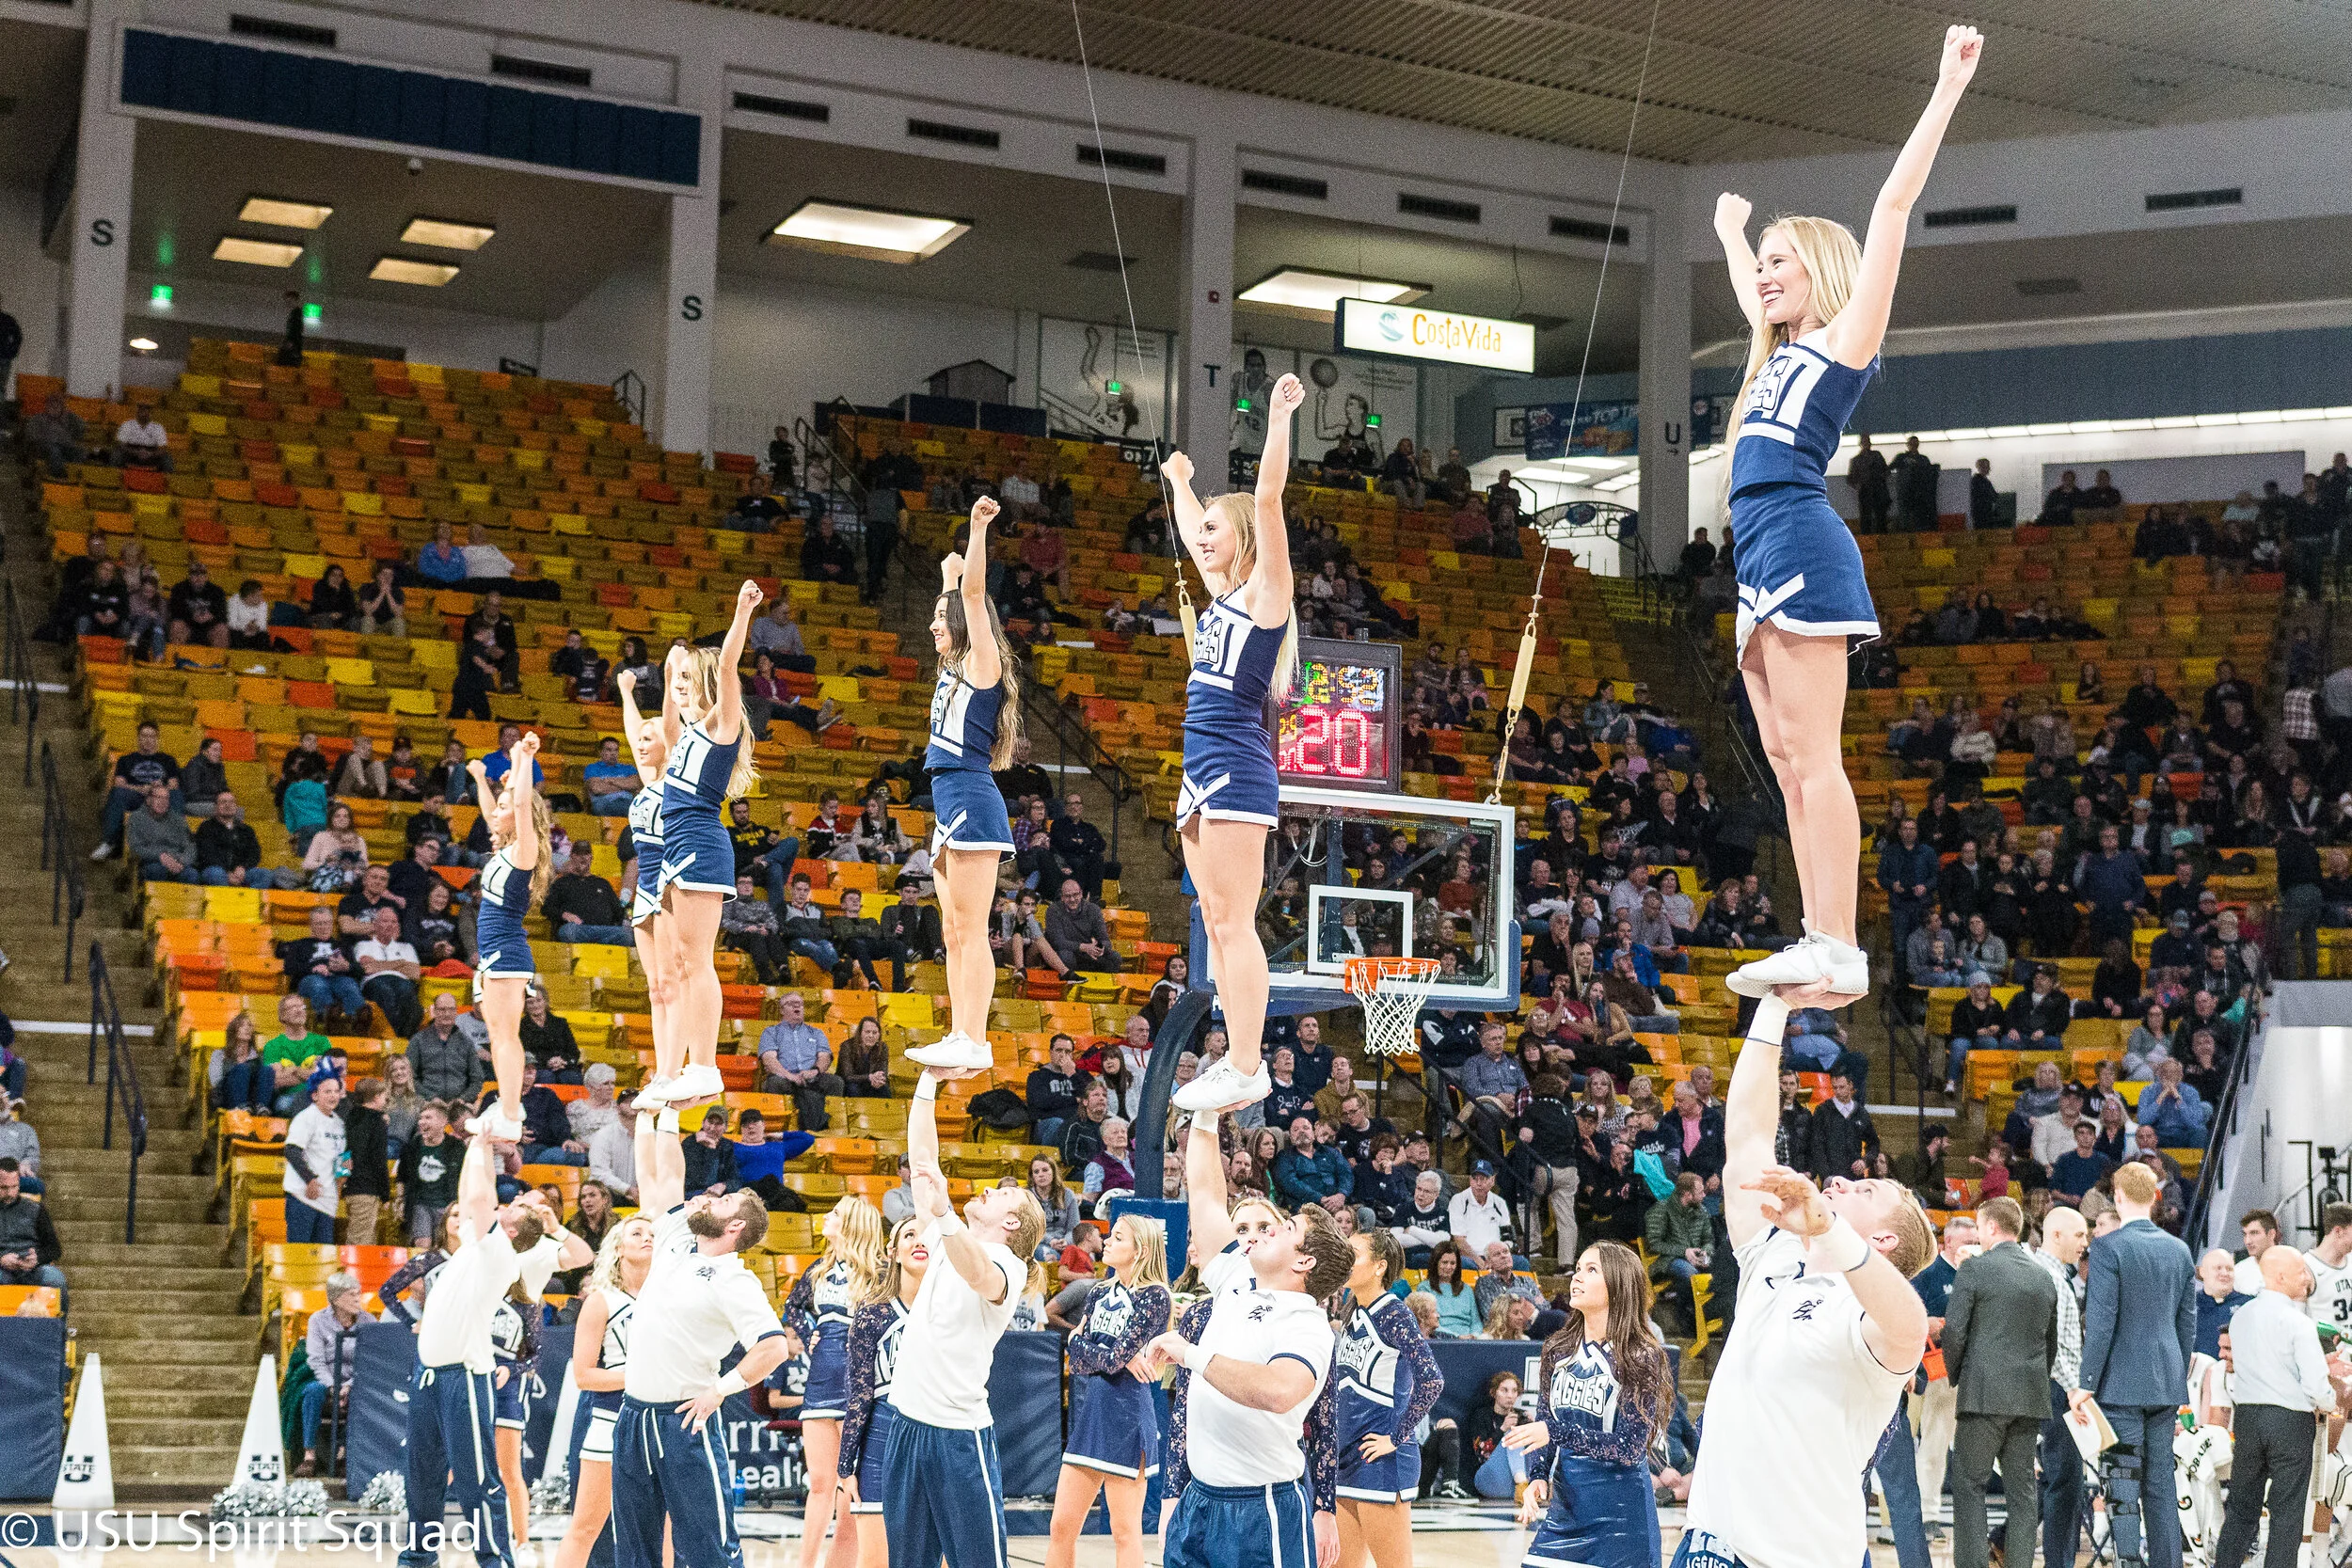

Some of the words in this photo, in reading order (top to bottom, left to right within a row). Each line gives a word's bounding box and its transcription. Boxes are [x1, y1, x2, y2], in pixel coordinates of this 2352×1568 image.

[91, 218, 114, 246] S
[682, 295, 702, 321] S
[1203, 364, 1221, 388] T
[1665, 422, 1680, 445] U
[1297, 706, 1368, 776] 20
[1551, 1366, 1609, 1415] AGGIES
